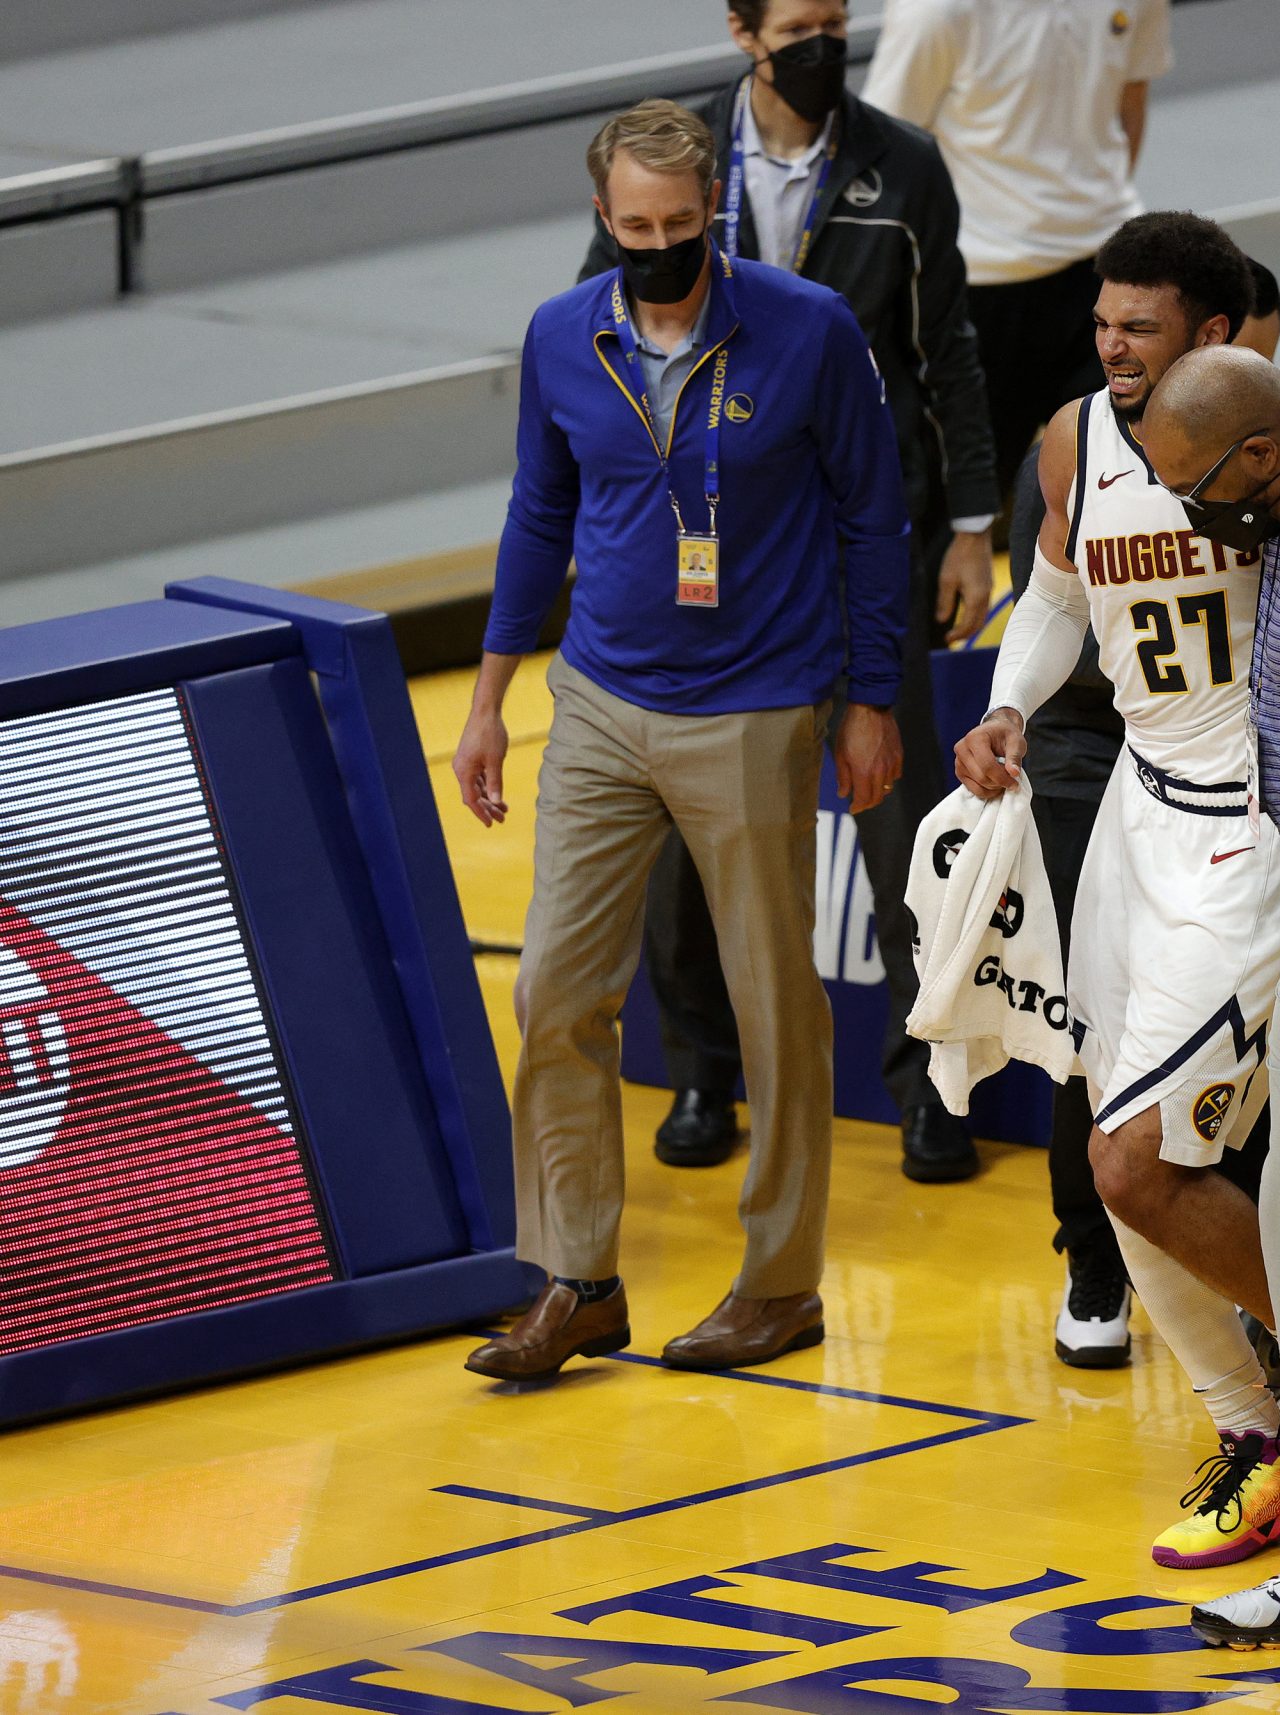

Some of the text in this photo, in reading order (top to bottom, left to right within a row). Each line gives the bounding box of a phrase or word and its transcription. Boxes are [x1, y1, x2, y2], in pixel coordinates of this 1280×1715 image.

[707, 350, 728, 429] WARRIORS
[1127, 588, 1235, 696] 27
[158, 1543, 1086, 1715] TATE
